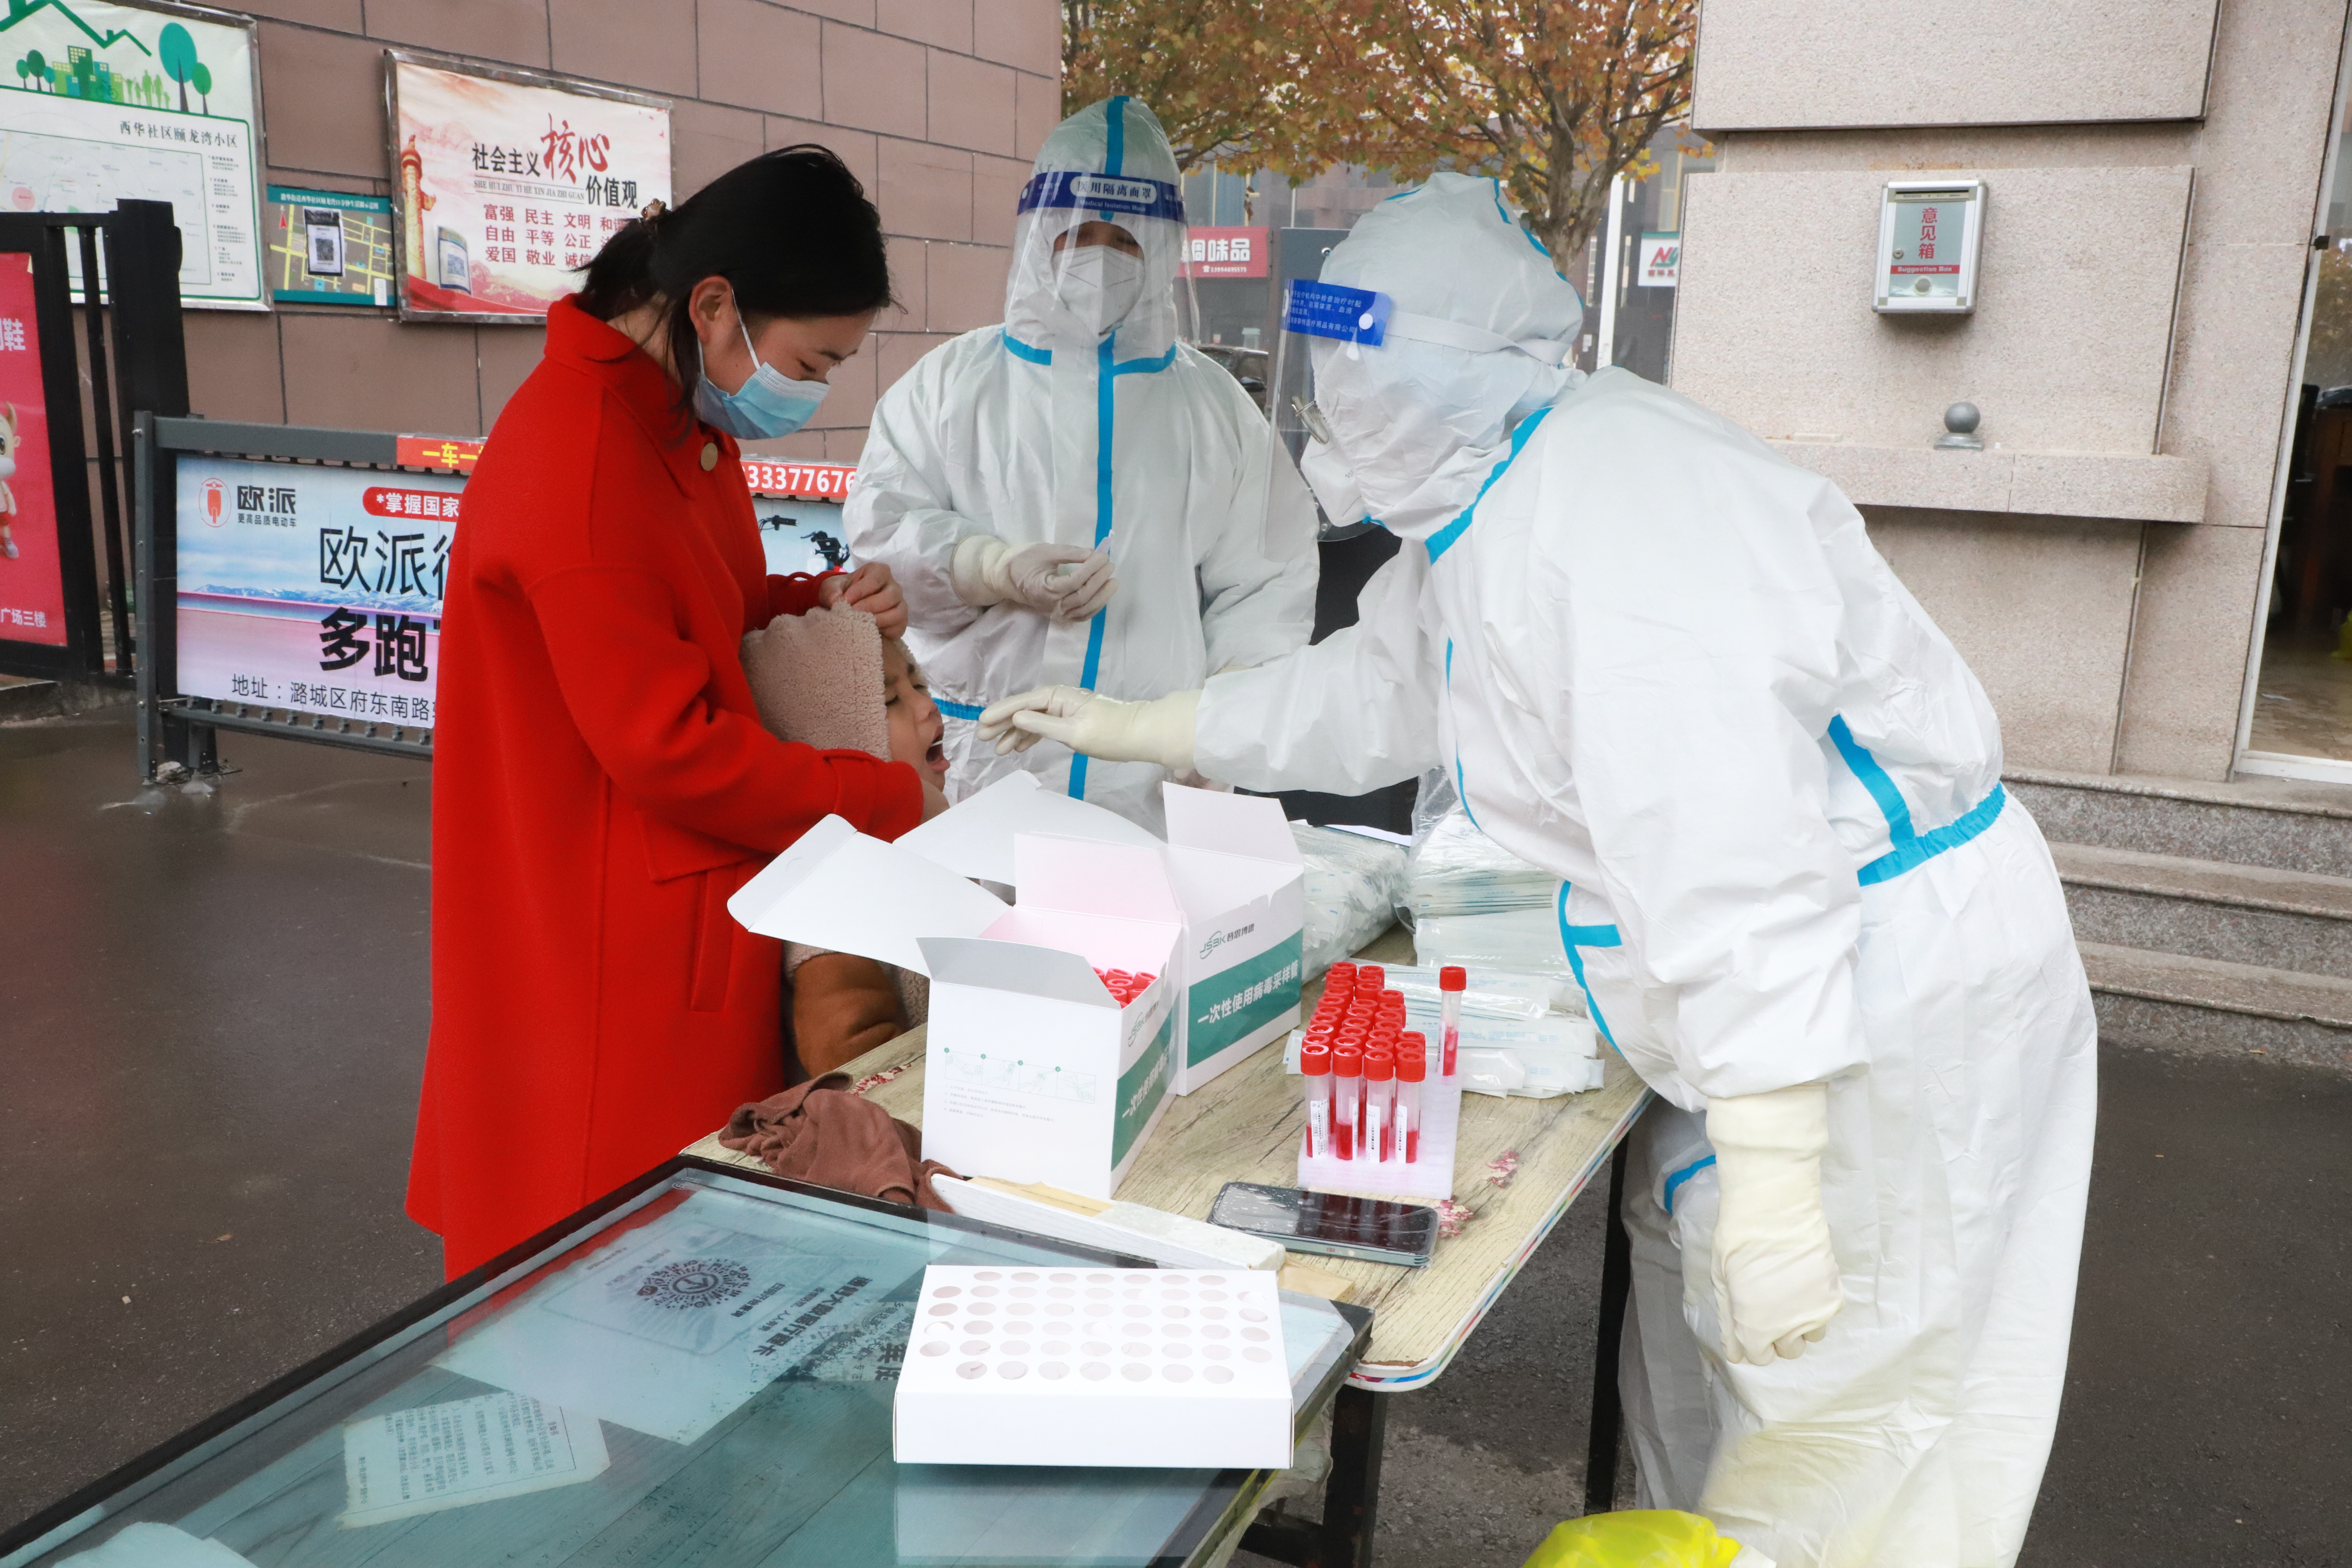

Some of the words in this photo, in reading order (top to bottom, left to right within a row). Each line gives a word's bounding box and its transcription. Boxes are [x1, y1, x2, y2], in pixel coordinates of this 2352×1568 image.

[120, 120, 237, 147] 西华社区颐龙湾小区
[472, 142, 541, 178] 社会主义
[541, 112, 610, 184] 核心
[586, 175, 638, 209] 价值观
[474, 180, 487, 188] SHE
[489, 181, 500, 190] HUI
[502, 182, 513, 191] ZHU
[524, 185, 532, 193] HE
[534, 187, 545, 195] XIN
[546, 188, 556, 196] JIA
[568, 191, 585, 200] GUAN
[1078, 181, 1151, 199] 医用隔离面罩
[484, 204, 514, 222] 富强
[525, 208, 554, 225] 民主
[564, 212, 591, 230] 文明
[1104, 202, 1130, 210] Isolation
[485, 225, 514, 243] 自由
[526, 229, 554, 246] 平等
[564, 233, 591, 249] 公正
[1918, 207, 1939, 259] 意见箱
[485, 246, 516, 263] 爱国
[526, 249, 556, 265] 敬业
[423, 443, 484, 468] 一车一
[237, 485, 296, 514] 欧派
[238, 513, 297, 528] 更高品质电动车
[0, 608, 46, 628] 广场三楼
[319, 606, 441, 682] 多跑
[231, 674, 435, 723] 地址：潞城区府东南路
[1197, 959, 1298, 1024] 一次性使用病毒采样管
[752, 1276, 873, 1357] 通信大数据行程卡
